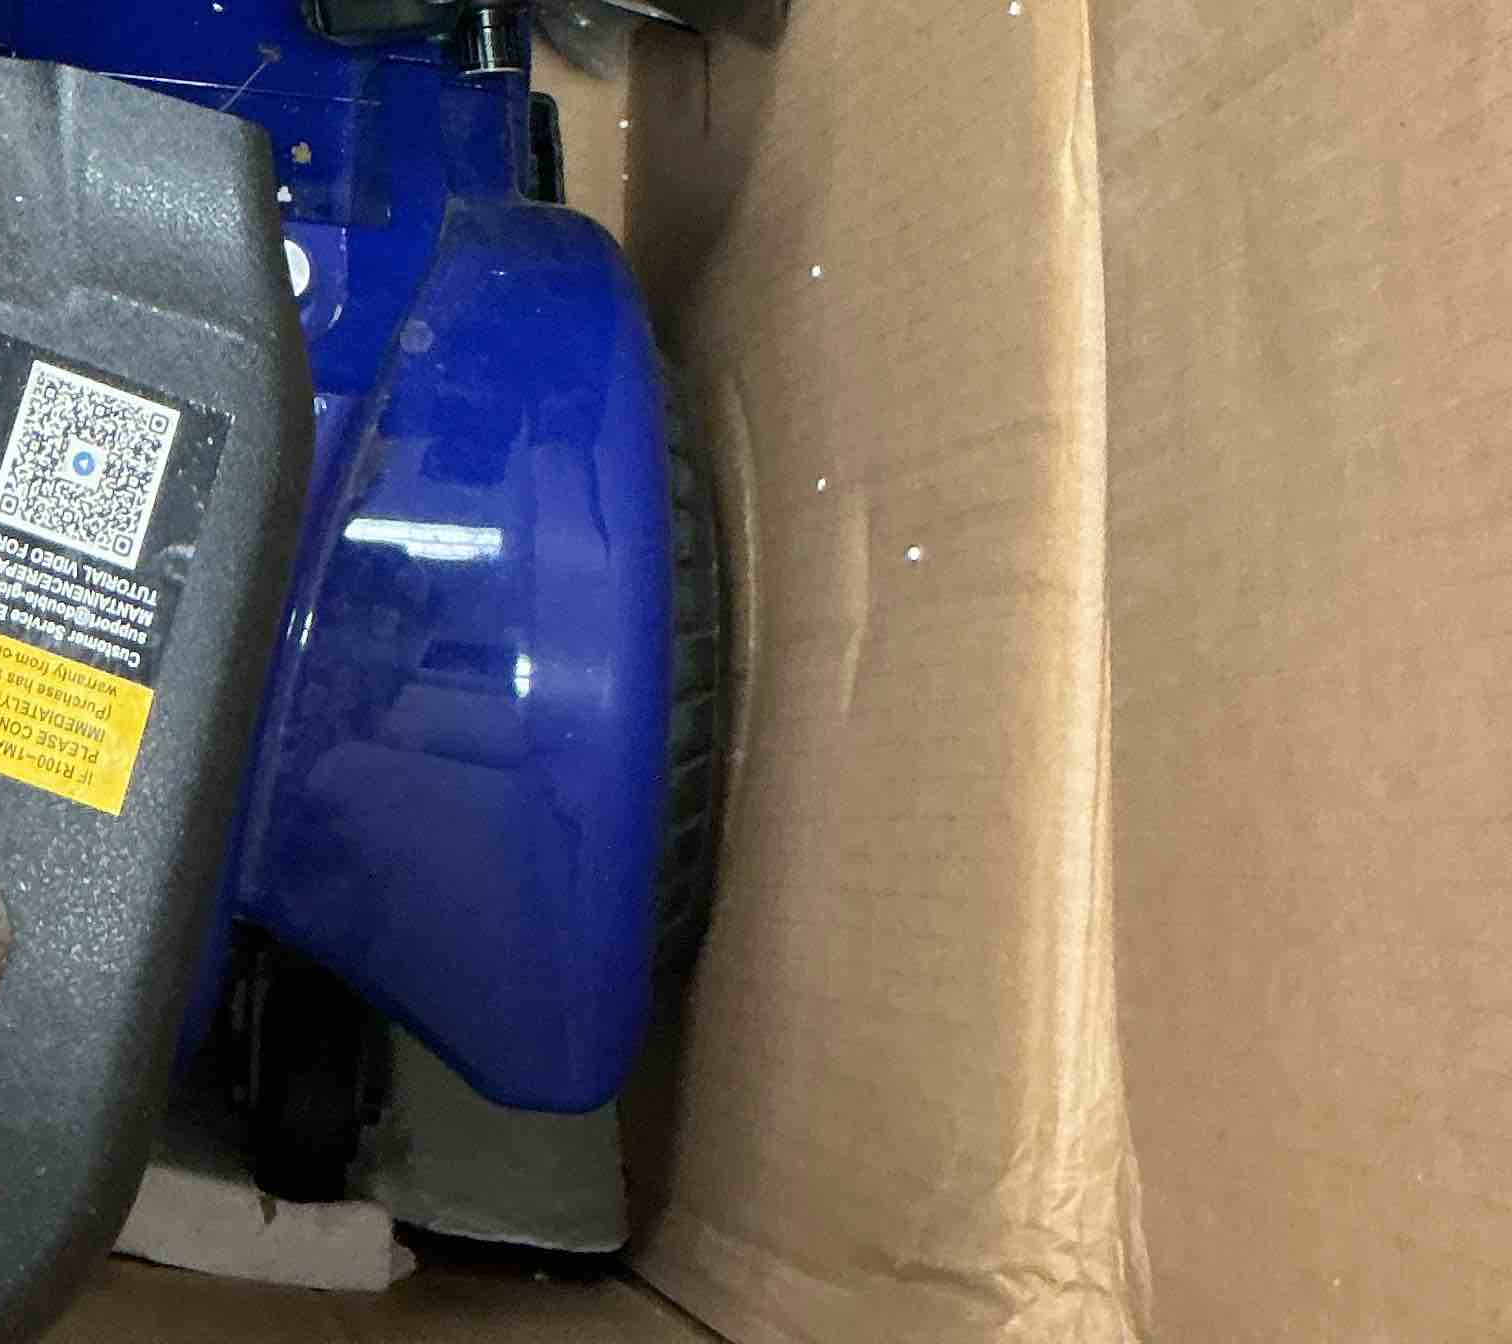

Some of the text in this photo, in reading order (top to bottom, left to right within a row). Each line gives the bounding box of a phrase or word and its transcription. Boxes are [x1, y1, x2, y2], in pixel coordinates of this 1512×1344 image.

[28, 546, 80, 577] VIDEO
[80, 562, 159, 605] TUTORIAL
[8, 608, 66, 640] Service
[14, 653, 50, 677] from
[66, 629, 142, 668] Customer
[6, 672, 34, 694] has
[52, 662, 118, 697] warranty
[35, 683, 113, 723] (Purchase
[36, 730, 99, 765] PLEASE
[78, 768, 94, 786] IF
